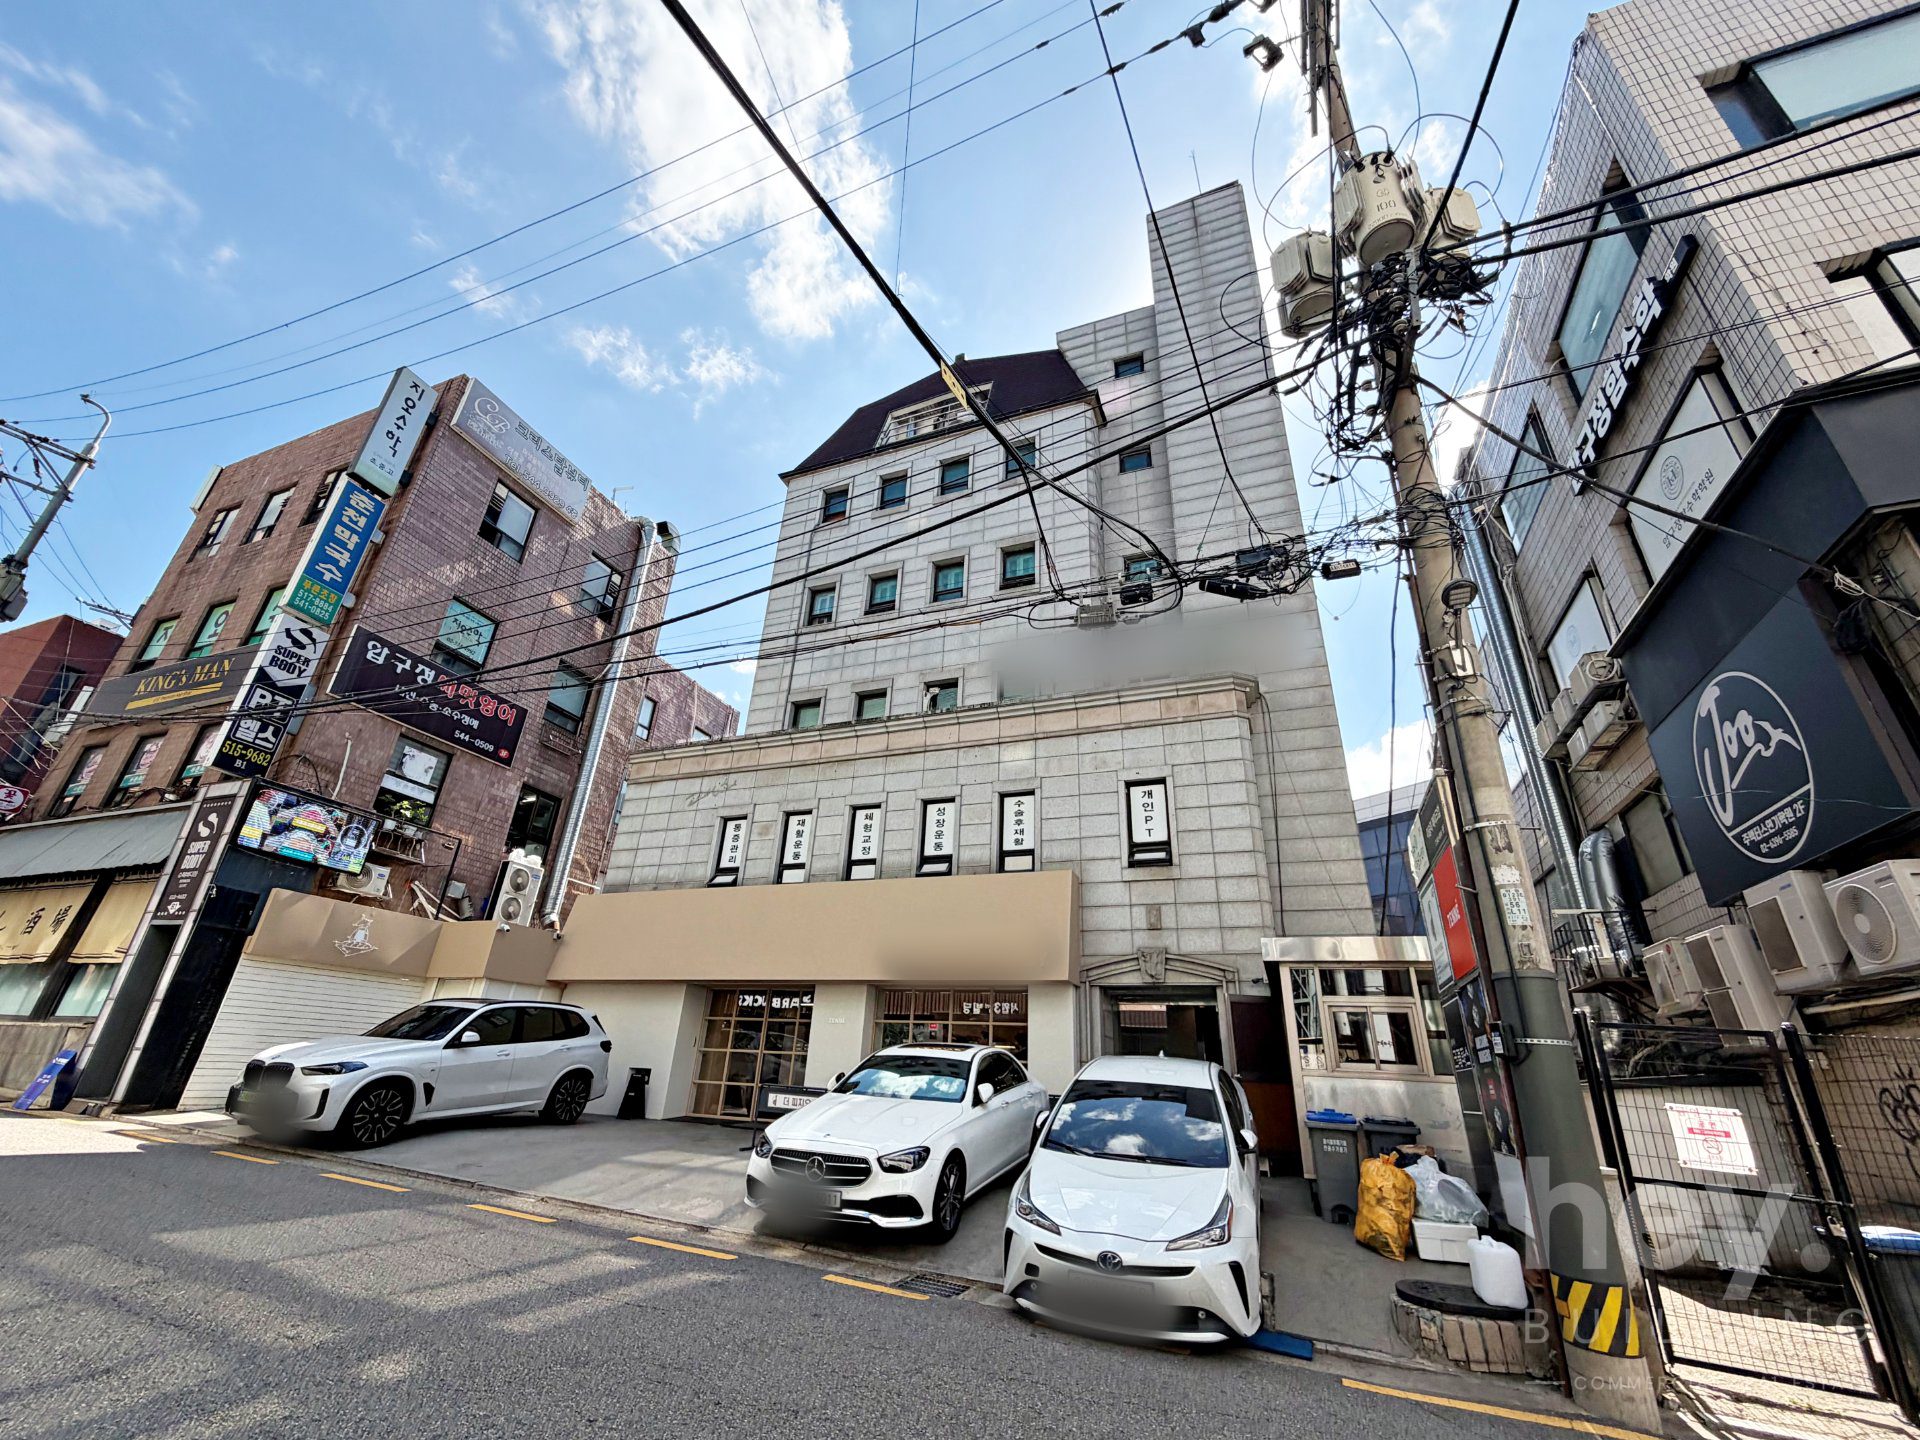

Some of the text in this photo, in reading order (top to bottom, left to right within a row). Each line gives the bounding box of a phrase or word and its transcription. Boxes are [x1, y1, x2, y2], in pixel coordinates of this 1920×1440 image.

[385, 380, 426, 458] 지오수학
[314, 490, 375, 583] 춘천막국수
[297, 589, 334, 613] 517-8884
[303, 579, 338, 604] 푸른초장
[293, 597, 330, 620] 541-0825
[268, 655, 308, 678] BODY
[274, 645, 311, 667] SUPER
[189, 657, 236, 684] MAN
[235, 719, 280, 749] 헬스
[222, 740, 271, 767] 515-9682
[233, 759, 247, 770] B1
[1792, 799, 1806, 818] 2F
[861, 812, 874, 855] 체형교정
[933, 806, 946, 852] 성장운동
[1013, 799, 1025, 846] 수술후재활
[187, 840, 211, 854] SUPER
[792, 819, 806, 861] 재활운동
[180, 853, 206, 870] BODY
